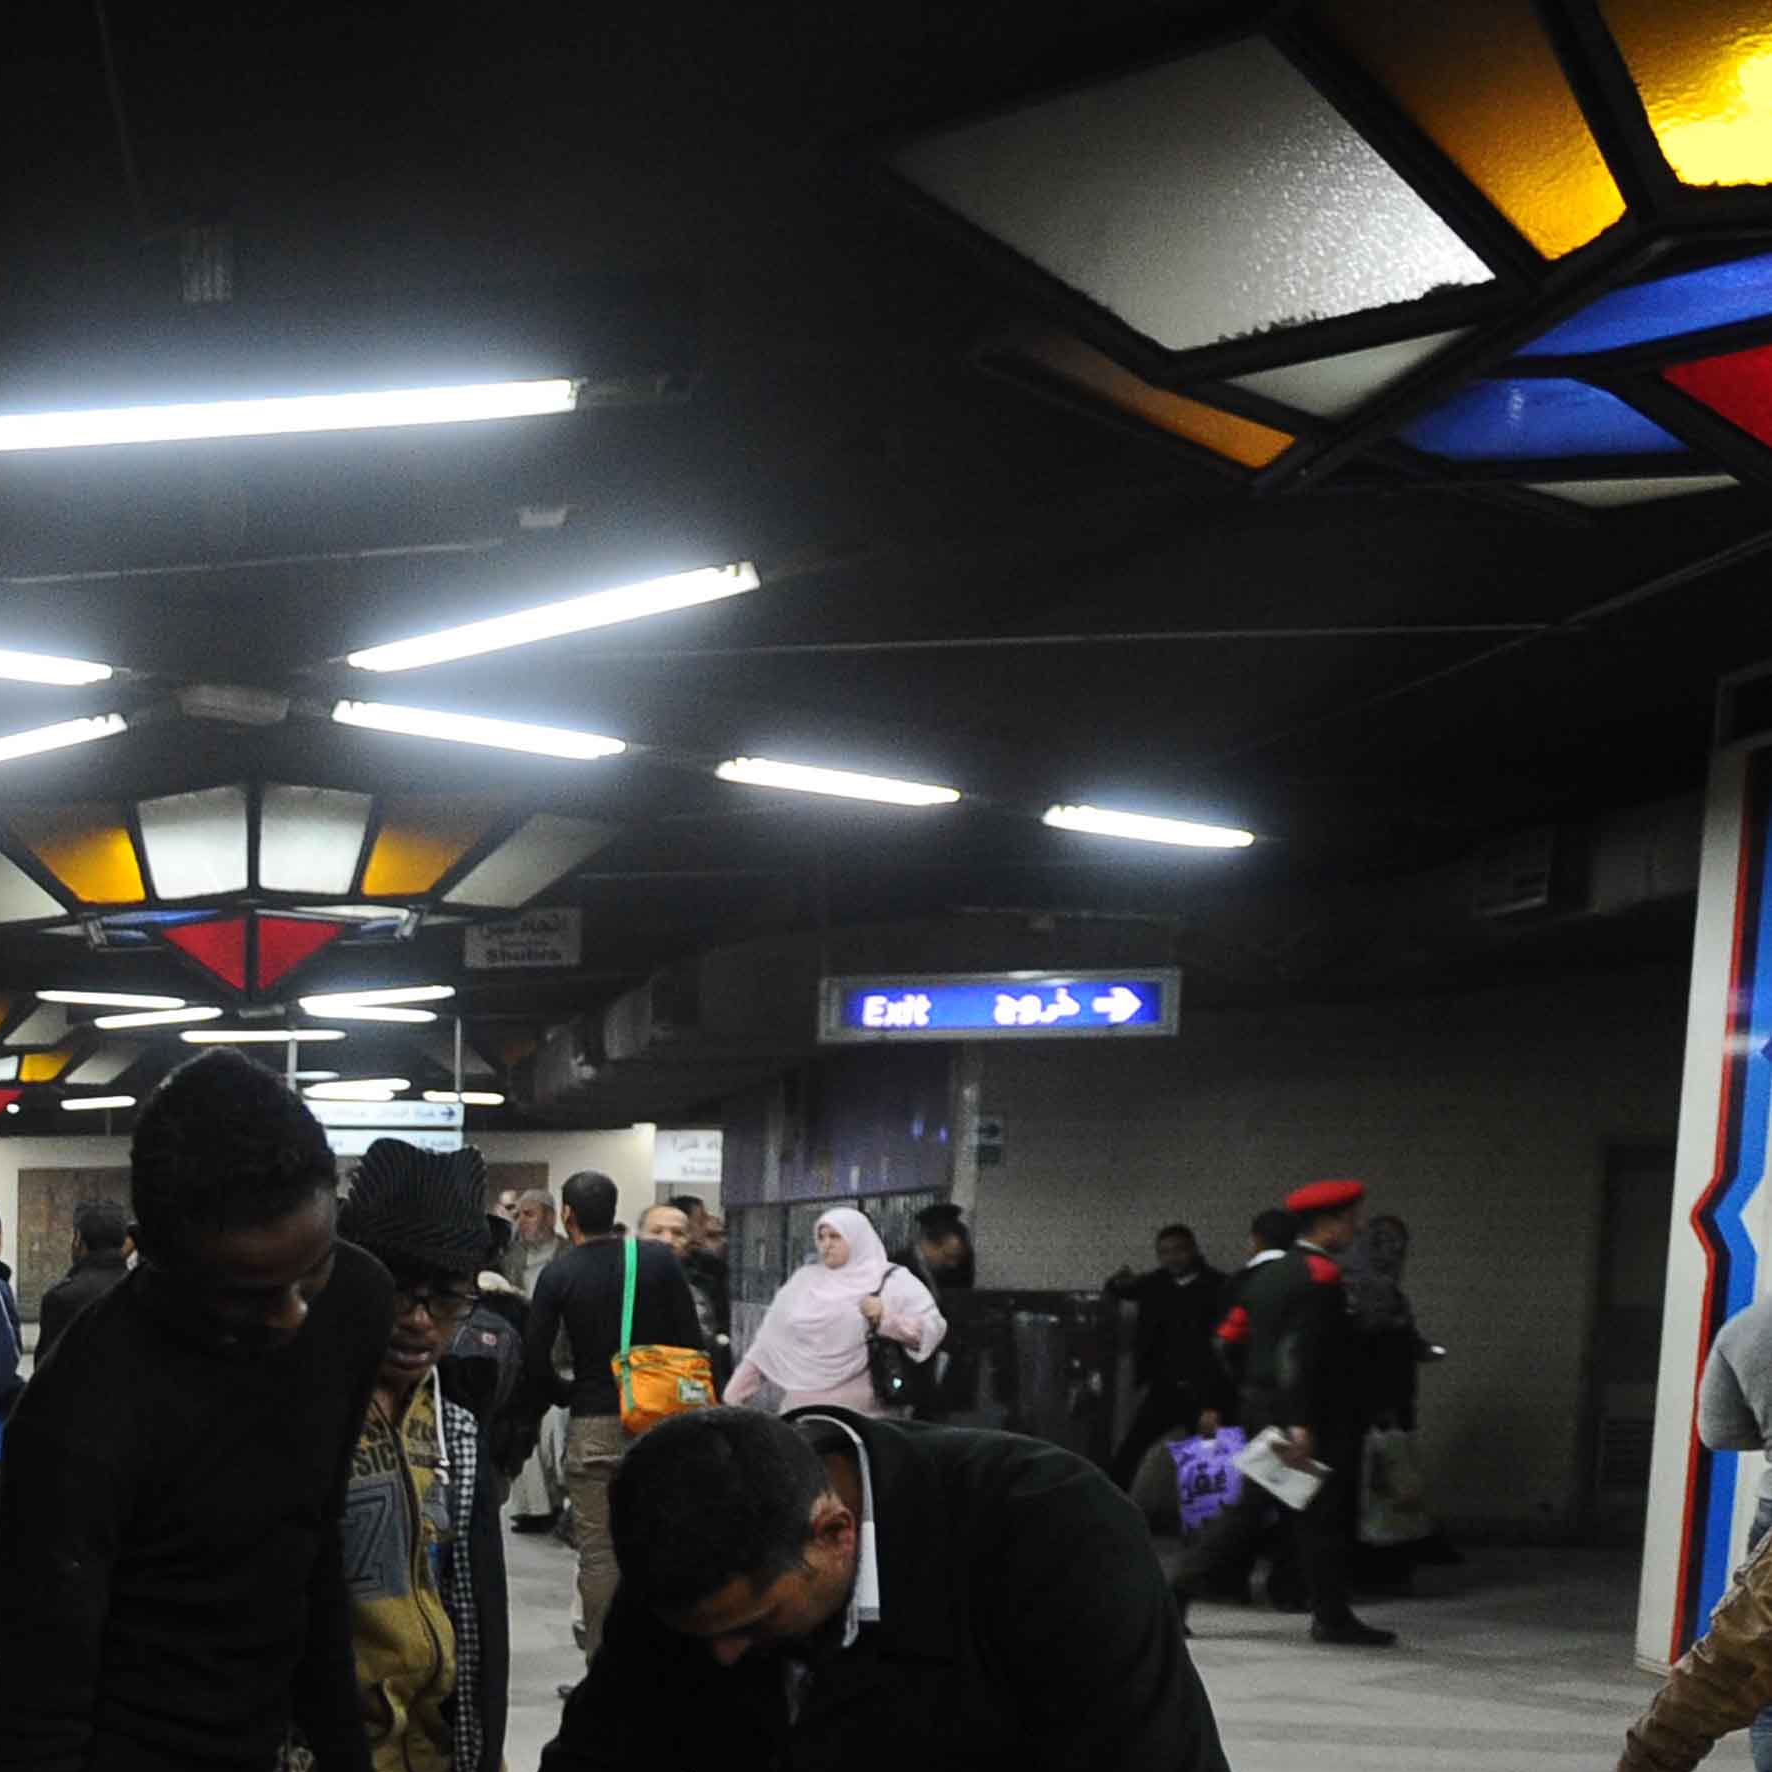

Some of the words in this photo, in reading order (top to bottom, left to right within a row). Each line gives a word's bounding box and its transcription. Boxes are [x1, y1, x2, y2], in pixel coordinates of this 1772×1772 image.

[862, 994, 932, 1027] Exit
[993, 987, 1080, 1026] خروج
[348, 1441, 397, 1479] SIC
